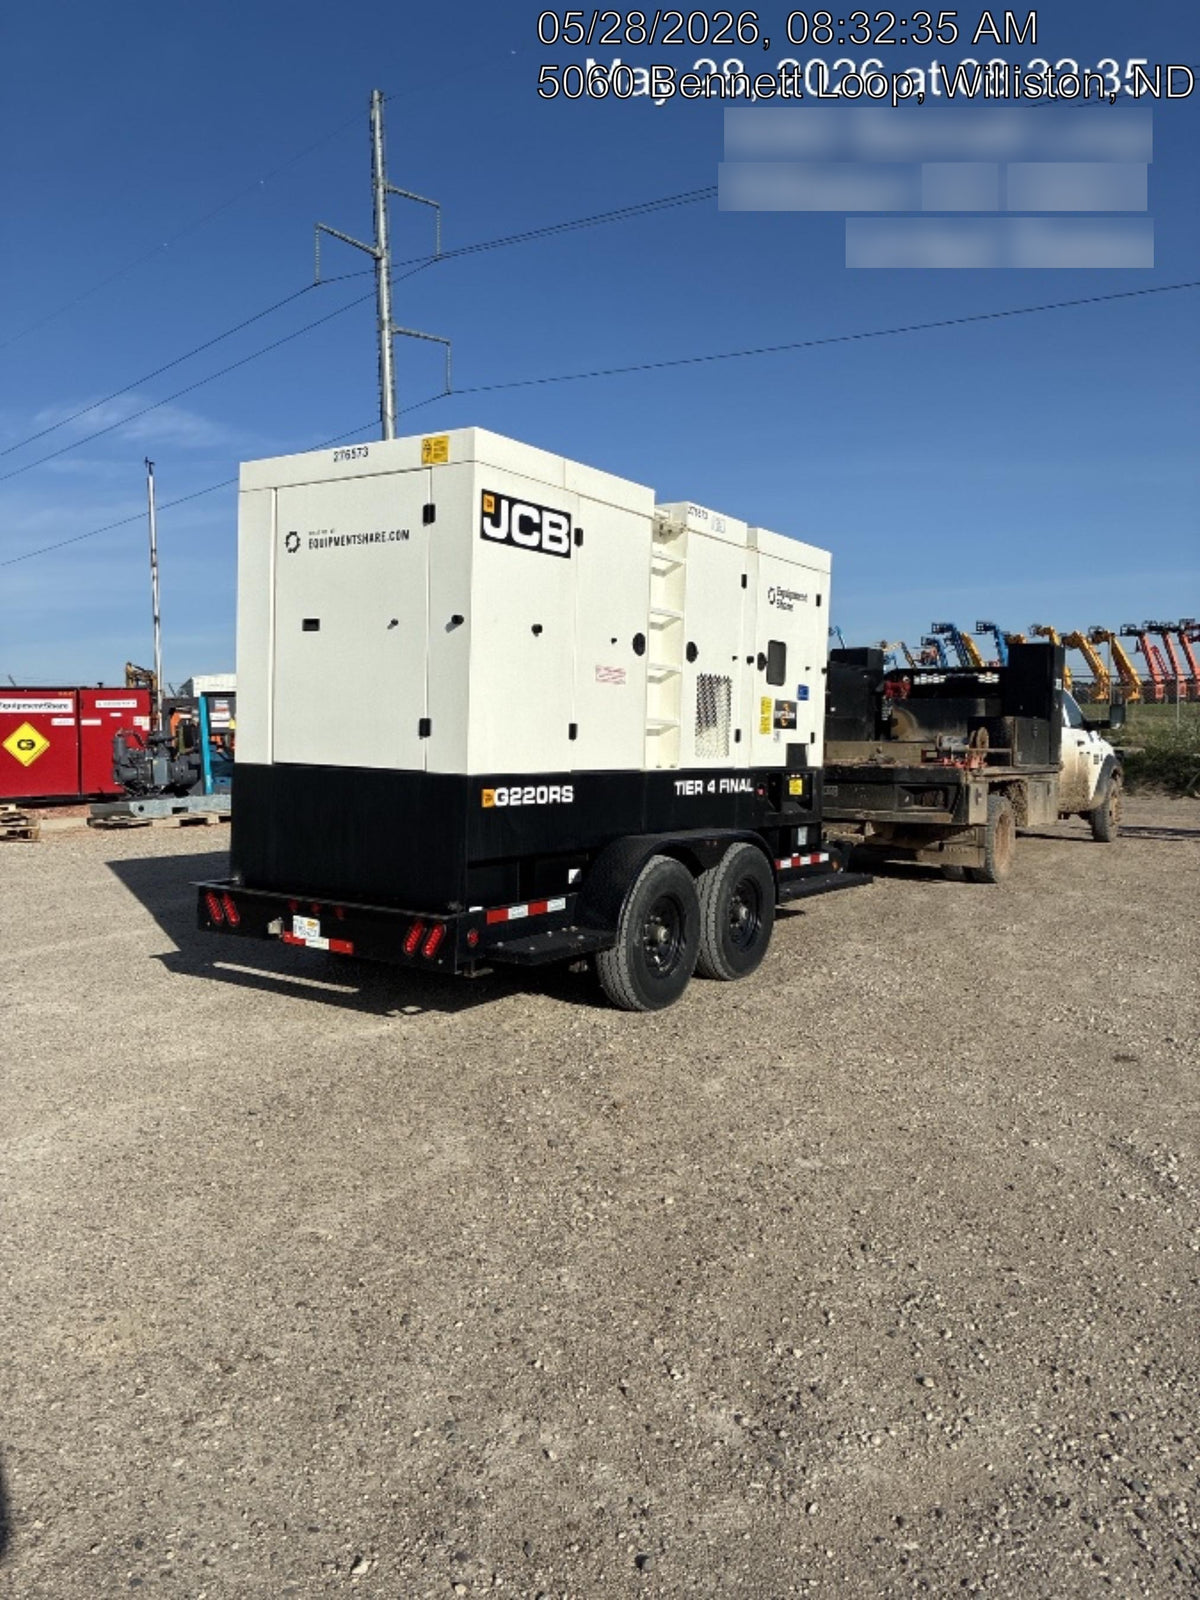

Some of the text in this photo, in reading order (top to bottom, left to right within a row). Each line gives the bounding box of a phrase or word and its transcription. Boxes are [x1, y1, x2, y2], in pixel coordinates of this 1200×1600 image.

[482, 498, 570, 554] JCB
[308, 529, 410, 550] EQUIPMENTSHARE.COM
[493, 785, 574, 807] G220RS
[674, 777, 755, 796] TIER 4 FINAL
